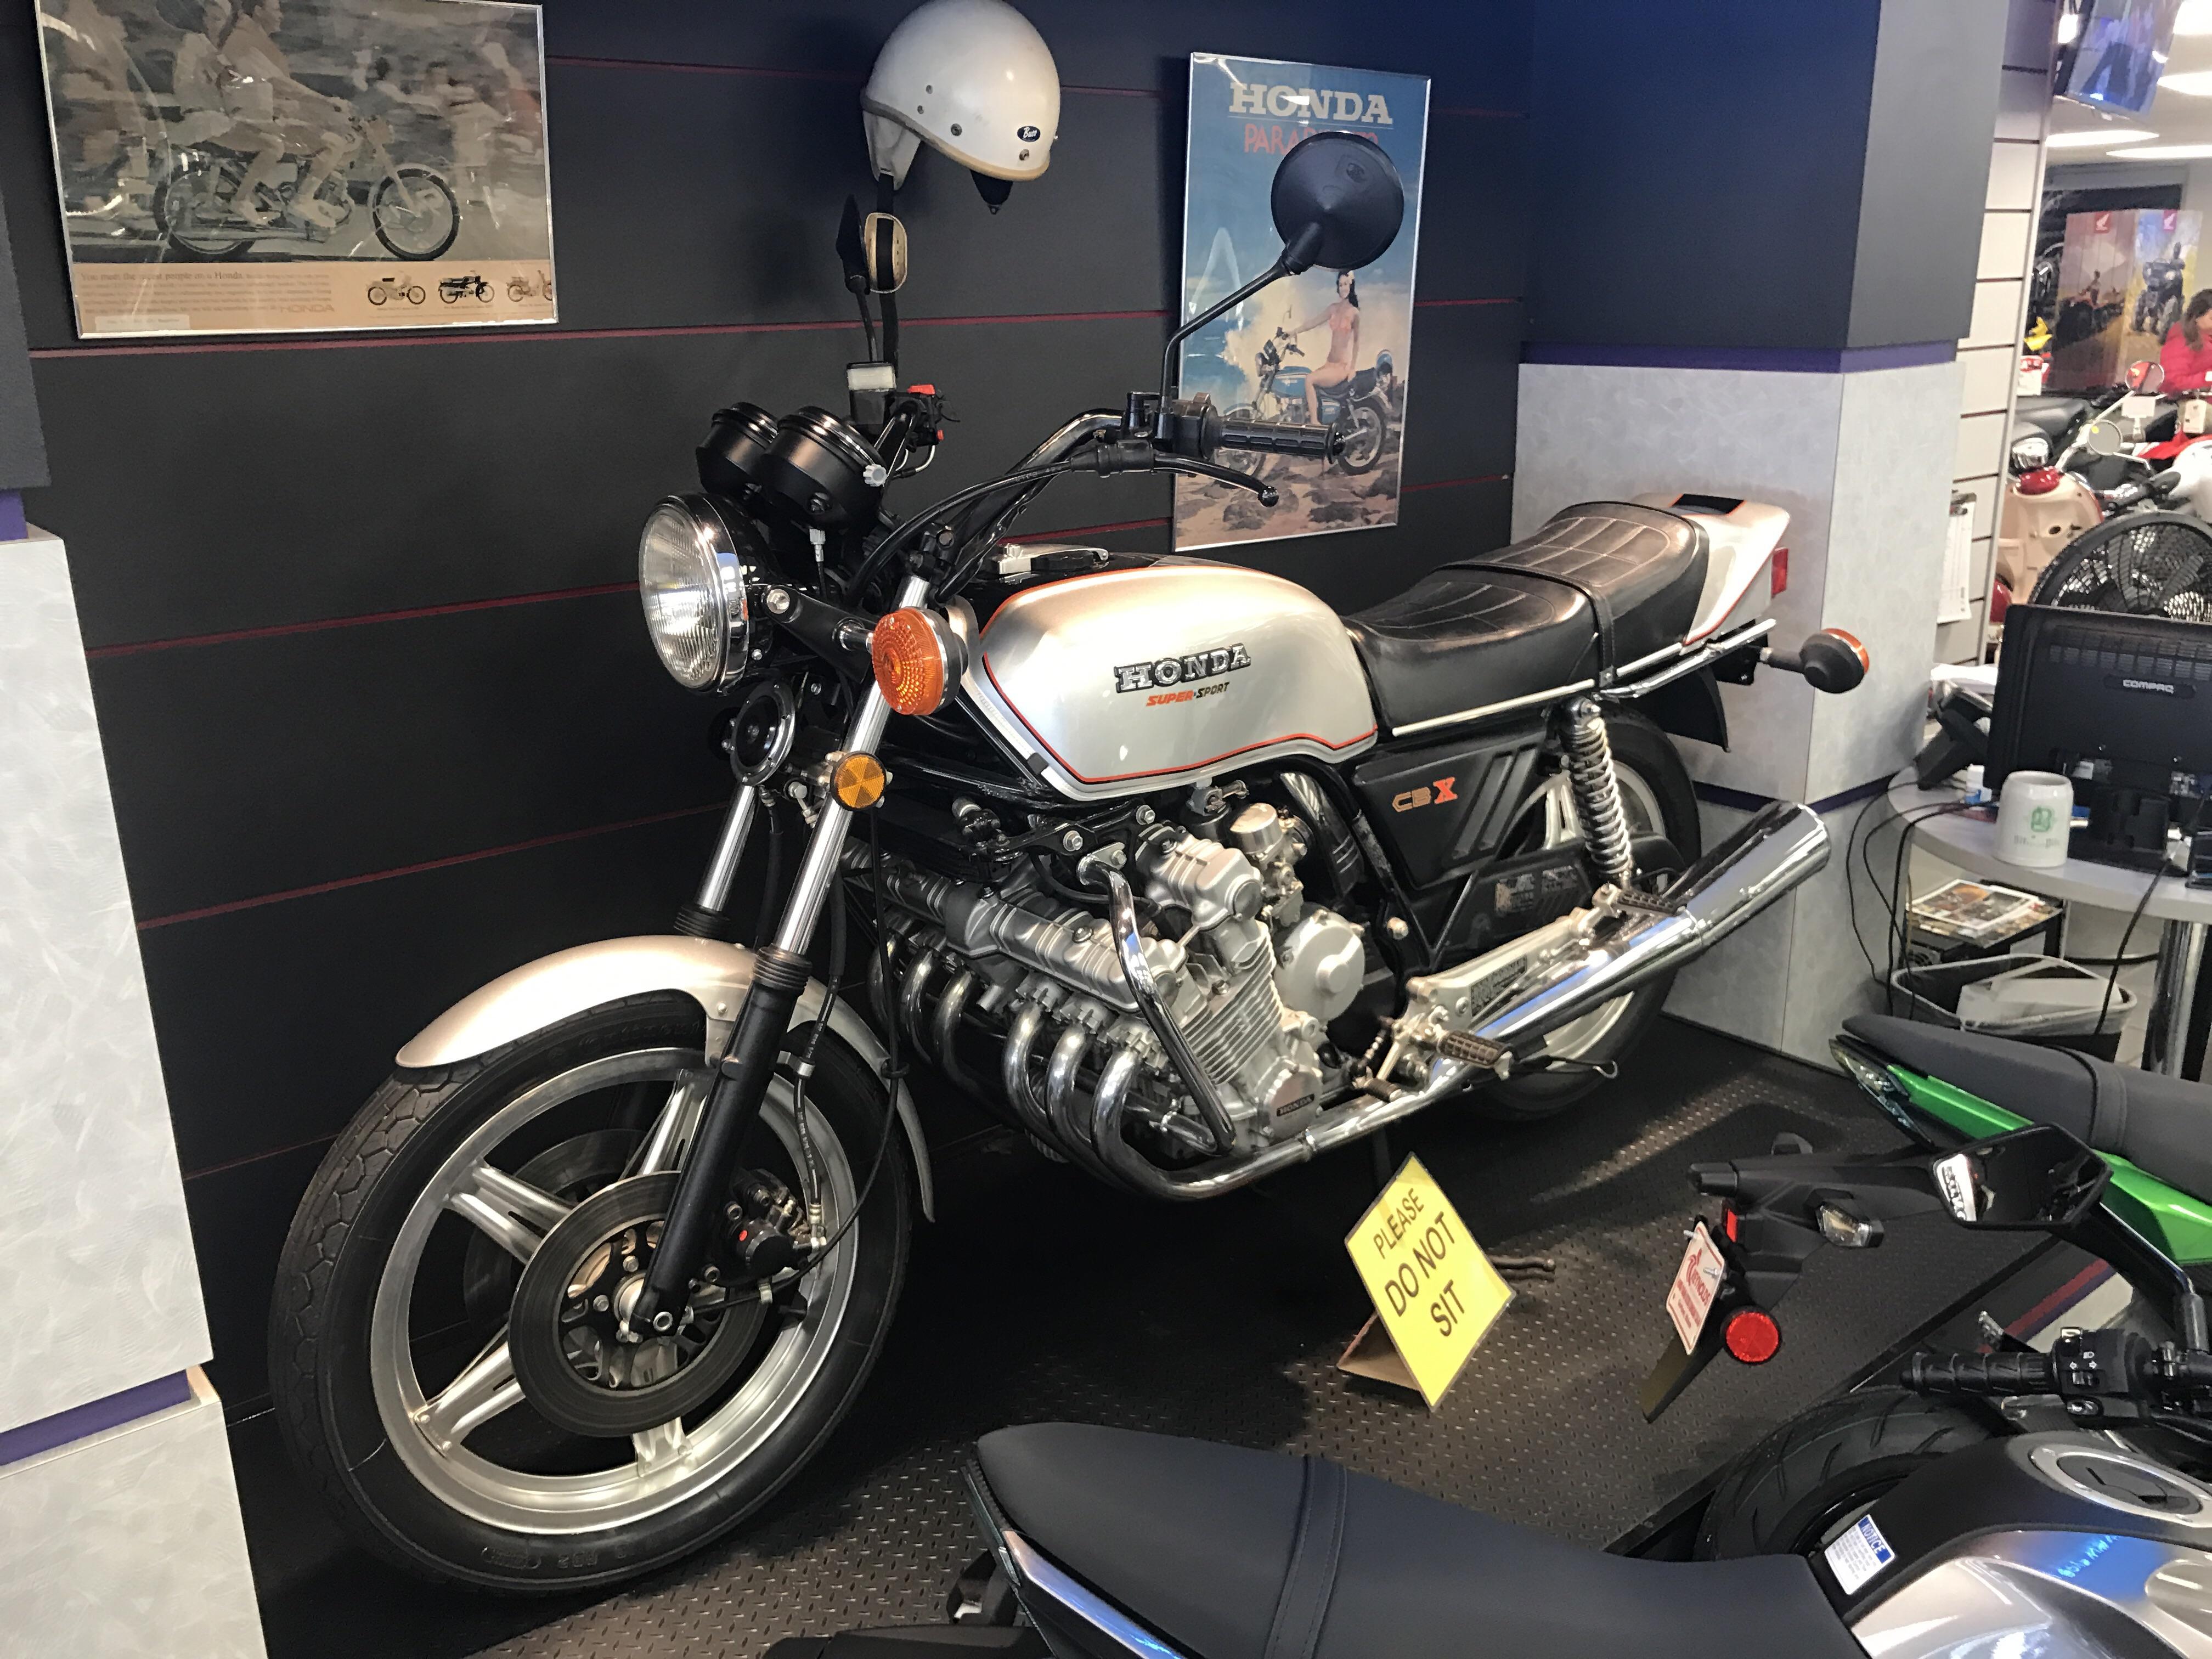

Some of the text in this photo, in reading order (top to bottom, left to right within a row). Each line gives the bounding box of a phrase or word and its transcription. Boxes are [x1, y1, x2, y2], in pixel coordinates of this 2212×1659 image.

[1229, 82, 1393, 125] HONDA
[280, 303, 335, 313] HONDA
[1114, 642, 1251, 693] HONDA
[1373, 1187, 1425, 1259] PLEASE
[1384, 1211, 1455, 1317] DO NOT
[1430, 1279, 1465, 1337] SIT
[1860, 1523, 1886, 1554] NOTICE
